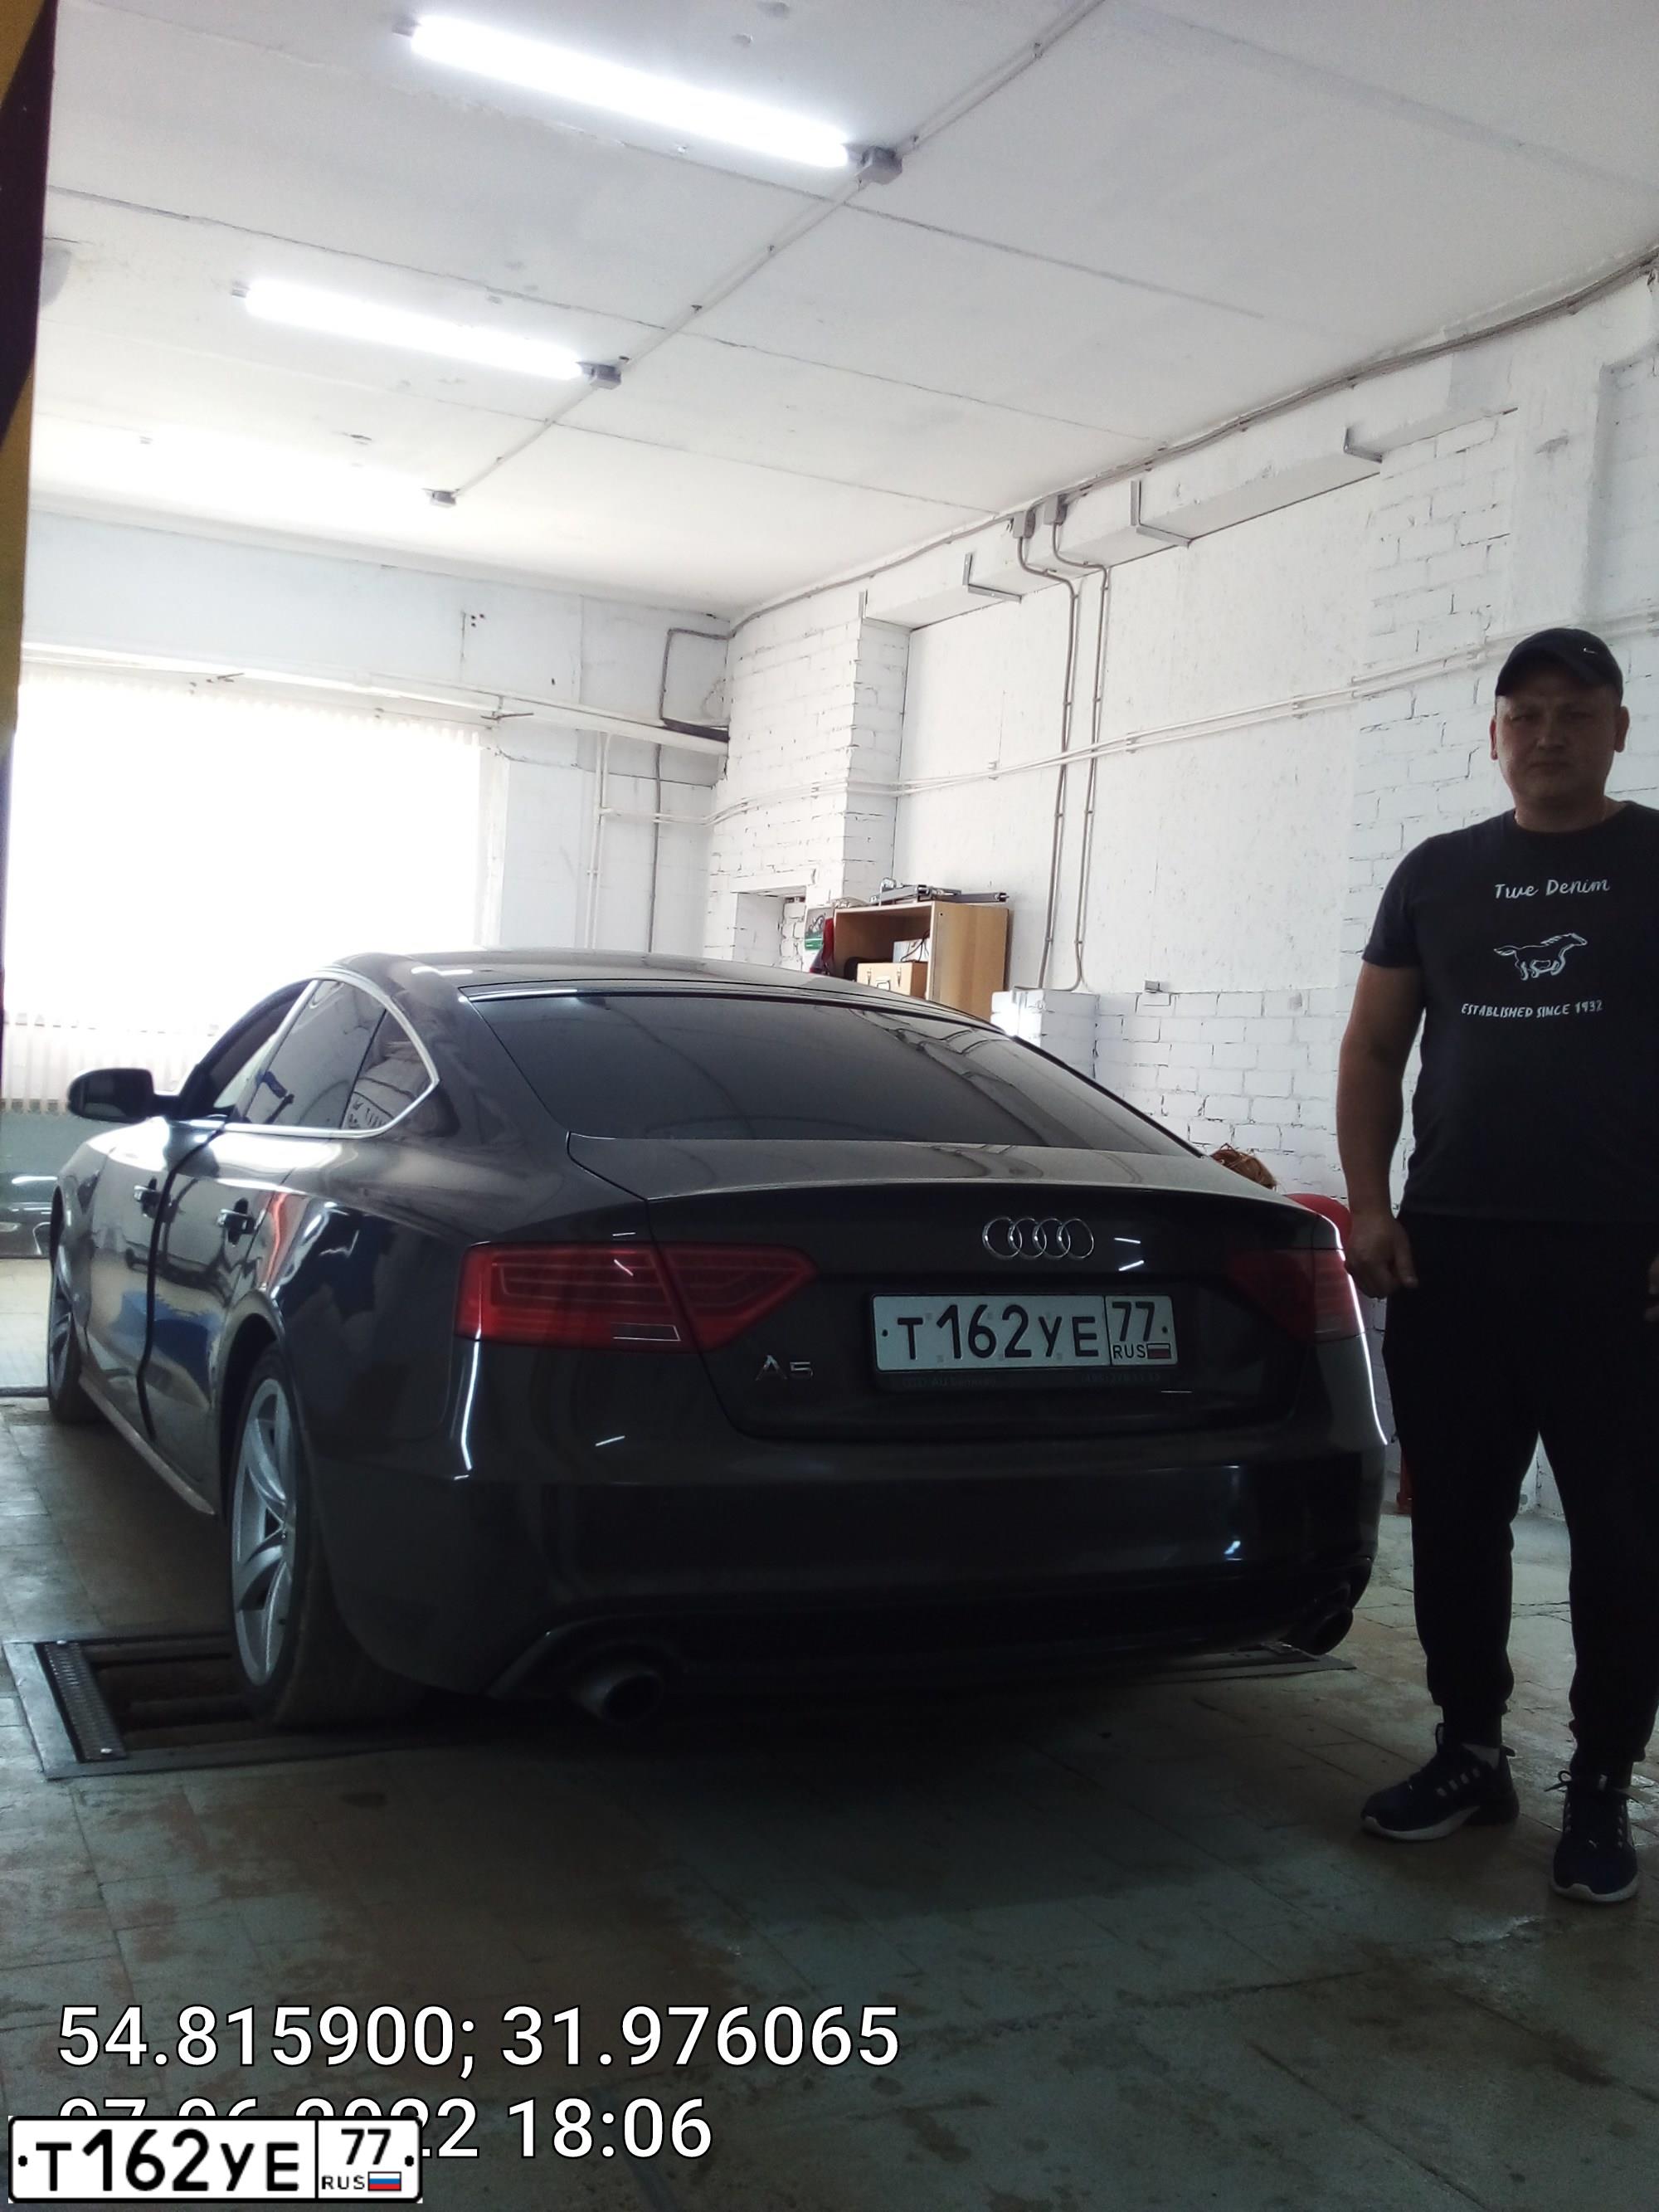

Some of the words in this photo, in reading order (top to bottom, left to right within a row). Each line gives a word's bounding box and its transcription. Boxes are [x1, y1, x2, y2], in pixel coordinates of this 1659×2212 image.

[1545, 879, 1610, 896] Denim
[1461, 1002, 1534, 1018] ESTABLISHED
[1536, 1003, 1571, 1018] SINCE
[1112, 1301, 1155, 1342] 77
[1112, 1344, 1146, 1359] RUS
[755, 1354, 814, 1381] A5
